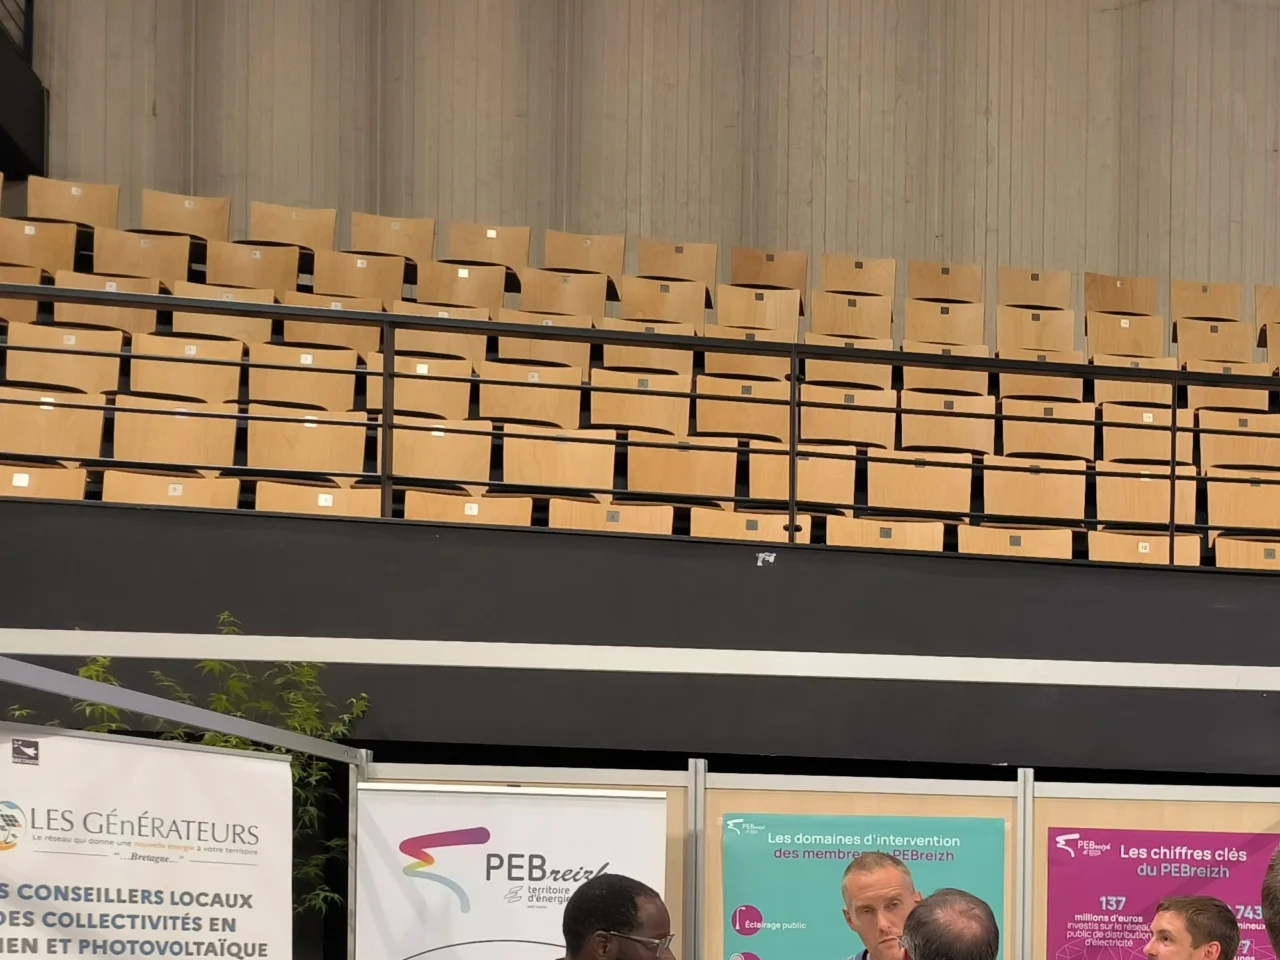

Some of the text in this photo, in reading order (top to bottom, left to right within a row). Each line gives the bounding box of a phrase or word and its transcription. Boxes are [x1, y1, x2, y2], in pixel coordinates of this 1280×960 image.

[30, 807, 75, 832] LES
[45, 834, 72, 843] réseau
[74, 837, 87, 845] qui
[88, 838, 115, 846] donne
[225, 847, 258, 856] territoire
[768, 832, 960, 848] Les domaines d'intervention
[773, 848, 799, 860] des
[802, 848, 866, 861] membre
[892, 849, 954, 861] PEBreizh
[1120, 844, 1247, 861] Les chiffres clés
[1137, 863, 1230, 878] du PEBreizh
[17, 883, 164, 906] CONSEILLERS
[170, 890, 254, 910] LOCAUX
[527, 885, 571, 895] territoire
[1099, 895, 1127, 911] 137
[42, 911, 203, 932] COLLECTIVITÉS
[209, 917, 237, 933] EN
[744, 920, 807, 931] Éclairage public
[1074, 913, 1143, 923] millions d'euros
[1067, 922, 1099, 930] investis
[1066, 930, 1092, 939] public
[1104, 931, 1152, 939] distribution
[0, 937, 268, 960] IEN ET PHOTOVOLTAÏQUE
[1084, 938, 1134, 948] d'électricité
